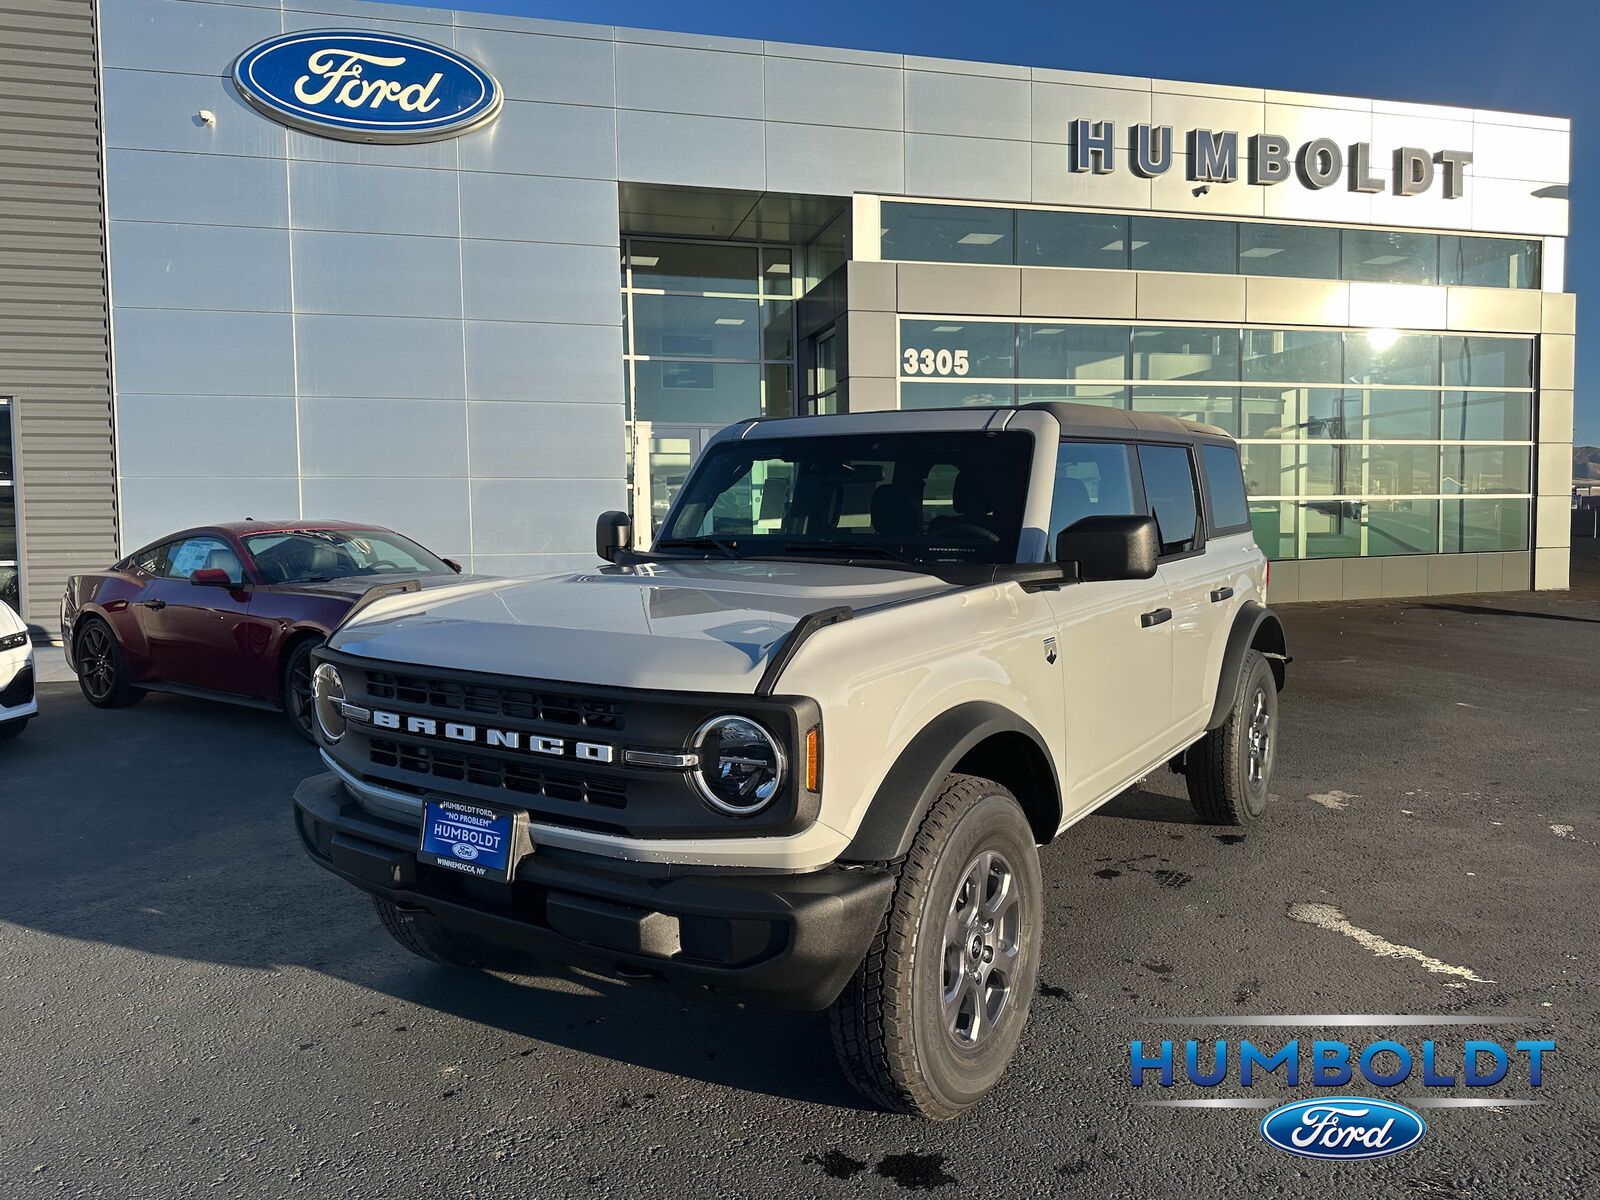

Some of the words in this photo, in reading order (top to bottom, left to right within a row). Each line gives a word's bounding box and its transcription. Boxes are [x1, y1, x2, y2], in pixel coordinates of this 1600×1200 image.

[294, 49, 443, 113] Ford
[1069, 118, 1473, 199] HUMBOLDT
[903, 348, 969, 376] 3305
[373, 711, 613, 763] BRONCO
[443, 801, 475, 814] HUMBOLDT
[434, 824, 501, 848] HUMBOLDT
[457, 846, 472, 857] Ford
[437, 858, 475, 874] WINNEMUCCA,
[476, 868, 486, 876] NV
